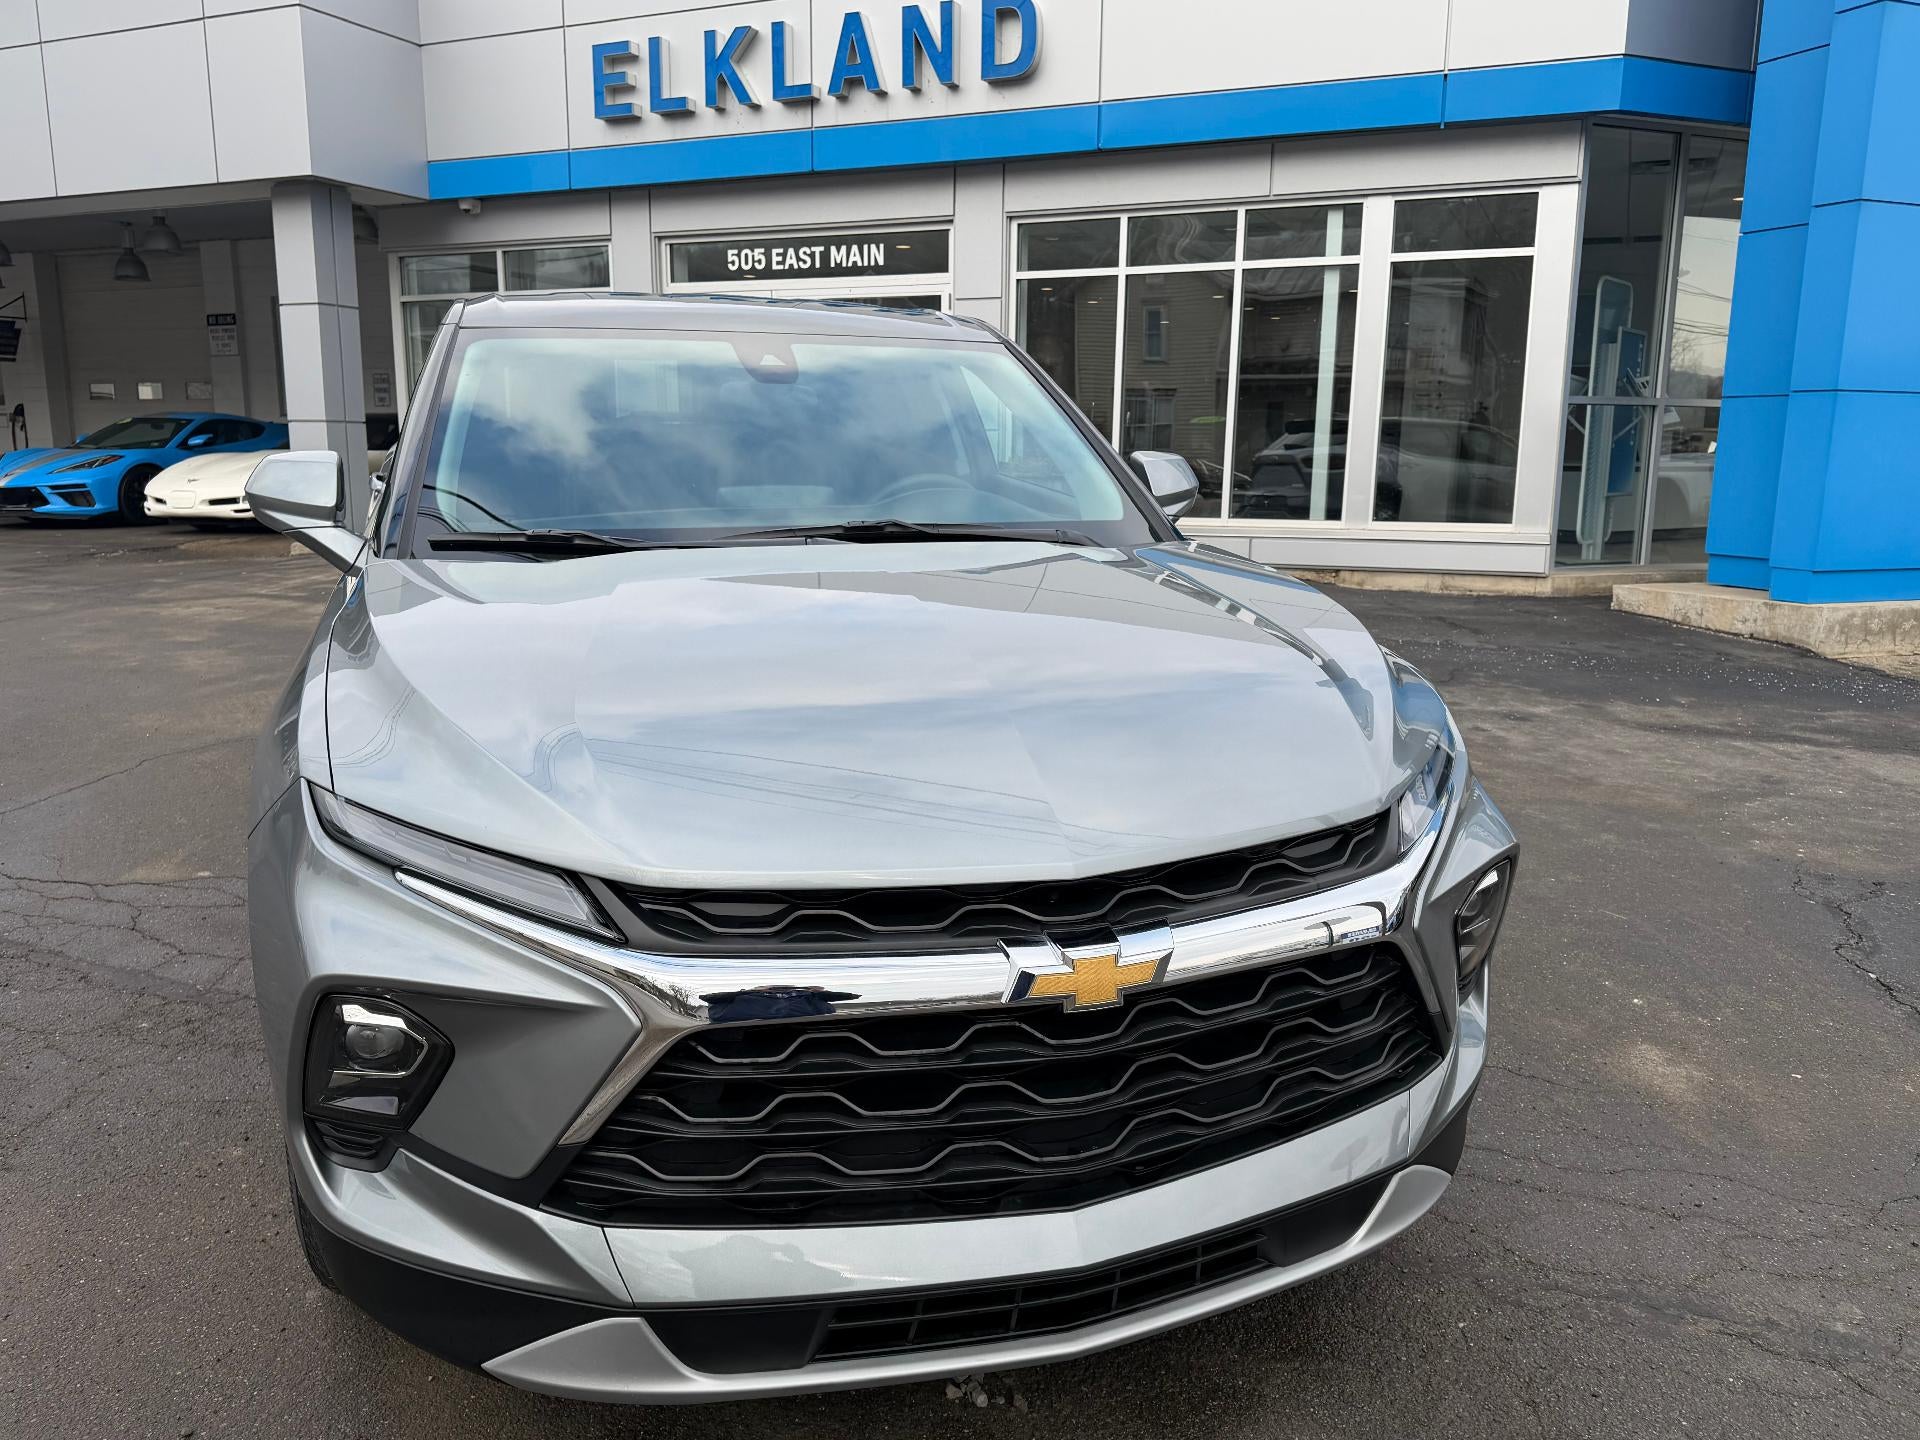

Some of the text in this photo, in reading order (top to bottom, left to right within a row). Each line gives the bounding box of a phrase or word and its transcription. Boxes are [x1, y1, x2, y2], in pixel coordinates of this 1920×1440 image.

[592, 0, 1042, 119] ELKLAND
[727, 243, 885, 271] 505 EAST MAIN
